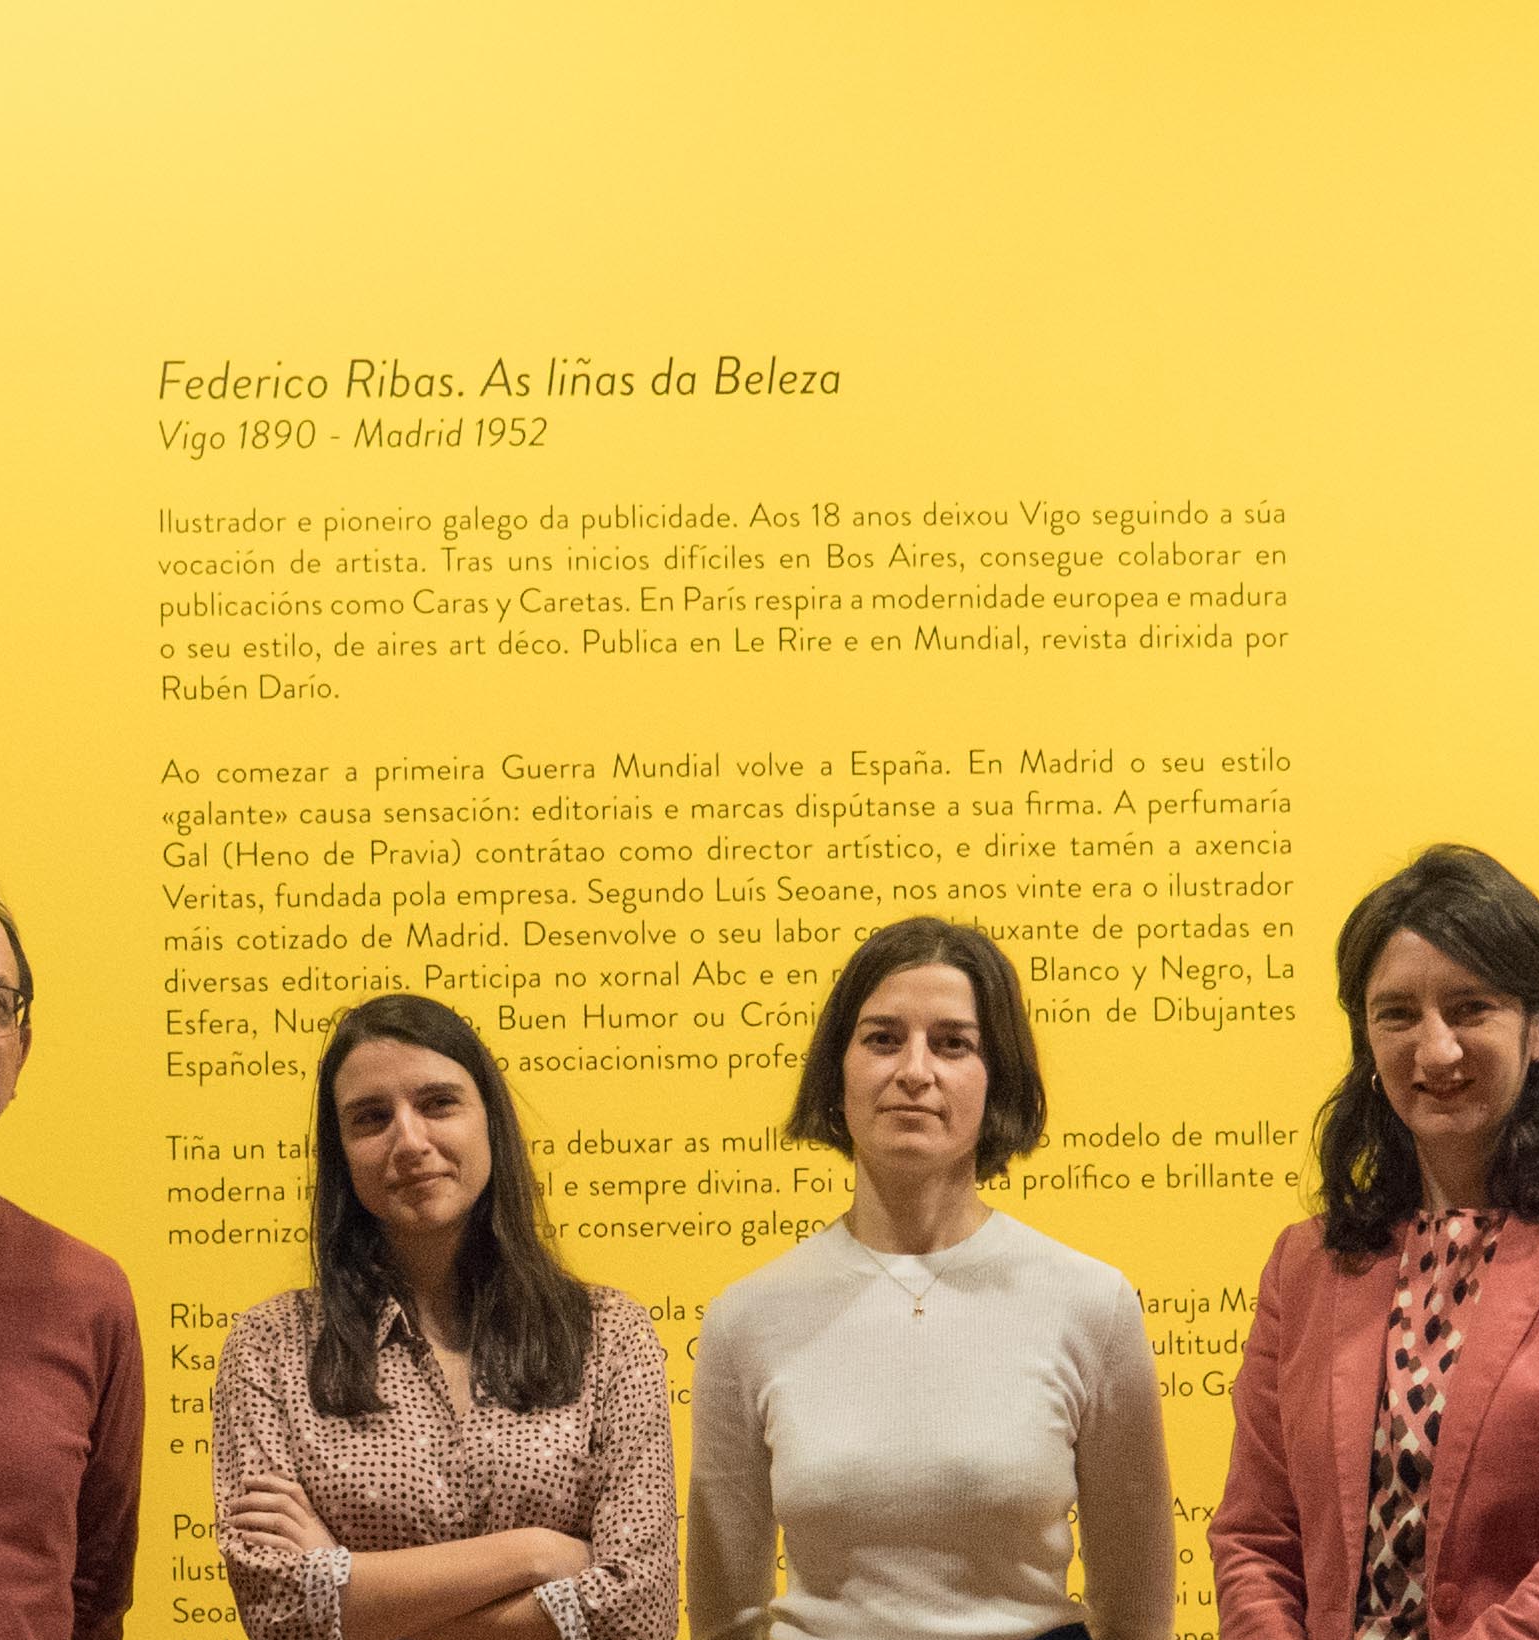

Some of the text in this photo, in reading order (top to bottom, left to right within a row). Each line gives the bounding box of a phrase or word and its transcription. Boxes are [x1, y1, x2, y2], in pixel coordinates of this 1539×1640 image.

[158, 354, 841, 401] Federico Ribas. As liñas da Beleza
[158, 419, 226, 462] Vigo
[239, 418, 317, 450] 1890
[353, 416, 464, 449] Madrid
[475, 416, 549, 448] 1952
[159, 506, 287, 535] Ilustrador
[297, 516, 313, 533] e
[323, 506, 432, 542] pioneiro
[539, 504, 569, 531] da
[581, 502, 738, 540] publicidade.
[748, 501, 801, 529] Aos
[811, 501, 841, 528] 18
[852, 510, 913, 528] anos
[922, 500, 1009, 527] deixou
[1018, 500, 1081, 537] Vigo
[1091, 499, 1209, 536] seguindo
[1219, 508, 1233, 525] a
[1244, 499, 1286, 525] súa
[157, 540, 1287, 578] vocación de artista. Tras uns inicios difíciles en Bos Aires, consegue colaborar en
[161, 673, 340, 702] Rubén Darío.
[160, 746, 1292, 792] Ao comezar a primeira Guerra Mundial volve a España. En Madrid o seu estilo
[161, 787, 1292, 838] «galante» causa sensación: editoriais e marcas dispútanse a sua firma. A perfumaría
[161, 870, 1295, 918] Veritas, fundada pola empresa. Segundo Luís Seoane, nos anos vinte era o ilustrador
[163, 967, 270, 995] diversas
[280, 965, 412, 993] editoriais.
[423, 964, 543, 1000] Participa
[554, 971, 588, 989] no
[599, 960, 680, 988] xornal
[691, 959, 747, 987] Abc
[758, 968, 775, 986] e
[785, 968, 818, 986] en
[1029, 955, 1120, 983] Blanco
[1131, 965, 1148, 992] y
[1160, 954, 1253, 991] Negro,
[1265, 953, 1295, 980] La
[165, 1007, 258, 1040] Esfera,
[497, 1003, 567, 1032] Buen
[582, 1002, 679, 1030] Humor
[692, 1011, 725, 1029] ou
[1105, 996, 1138, 1024] de
[1153, 995, 1297, 1033] Dibujantes
[166, 1049, 307, 1088] Españoles,
[518, 1044, 719, 1073] asociacionismo
[164, 1134, 221, 1162] Tiña
[232, 1143, 266, 1161] un
[566, 1128, 674, 1156] debuxar
[683, 1136, 711, 1154] as
[1062, 1121, 1161, 1149] modelo
[1170, 1120, 1203, 1148] de
[1214, 1119, 1299, 1147] muller
[166, 1175, 286, 1204] moderna
[563, 1180, 579, 1198] e
[588, 1178, 688, 1206] sempre
[696, 1168, 781, 1196] divina.
[792, 1166, 833, 1194] Foi
[1022, 1162, 1131, 1201] prolífico
[1140, 1172, 1156, 1190] e
[1165, 1162, 1275, 1191] brillante
[1283, 1169, 1300, 1189] e
[577, 1210, 733, 1239] conserveiro
[1151, 1329, 1248, 1357] ultitud
